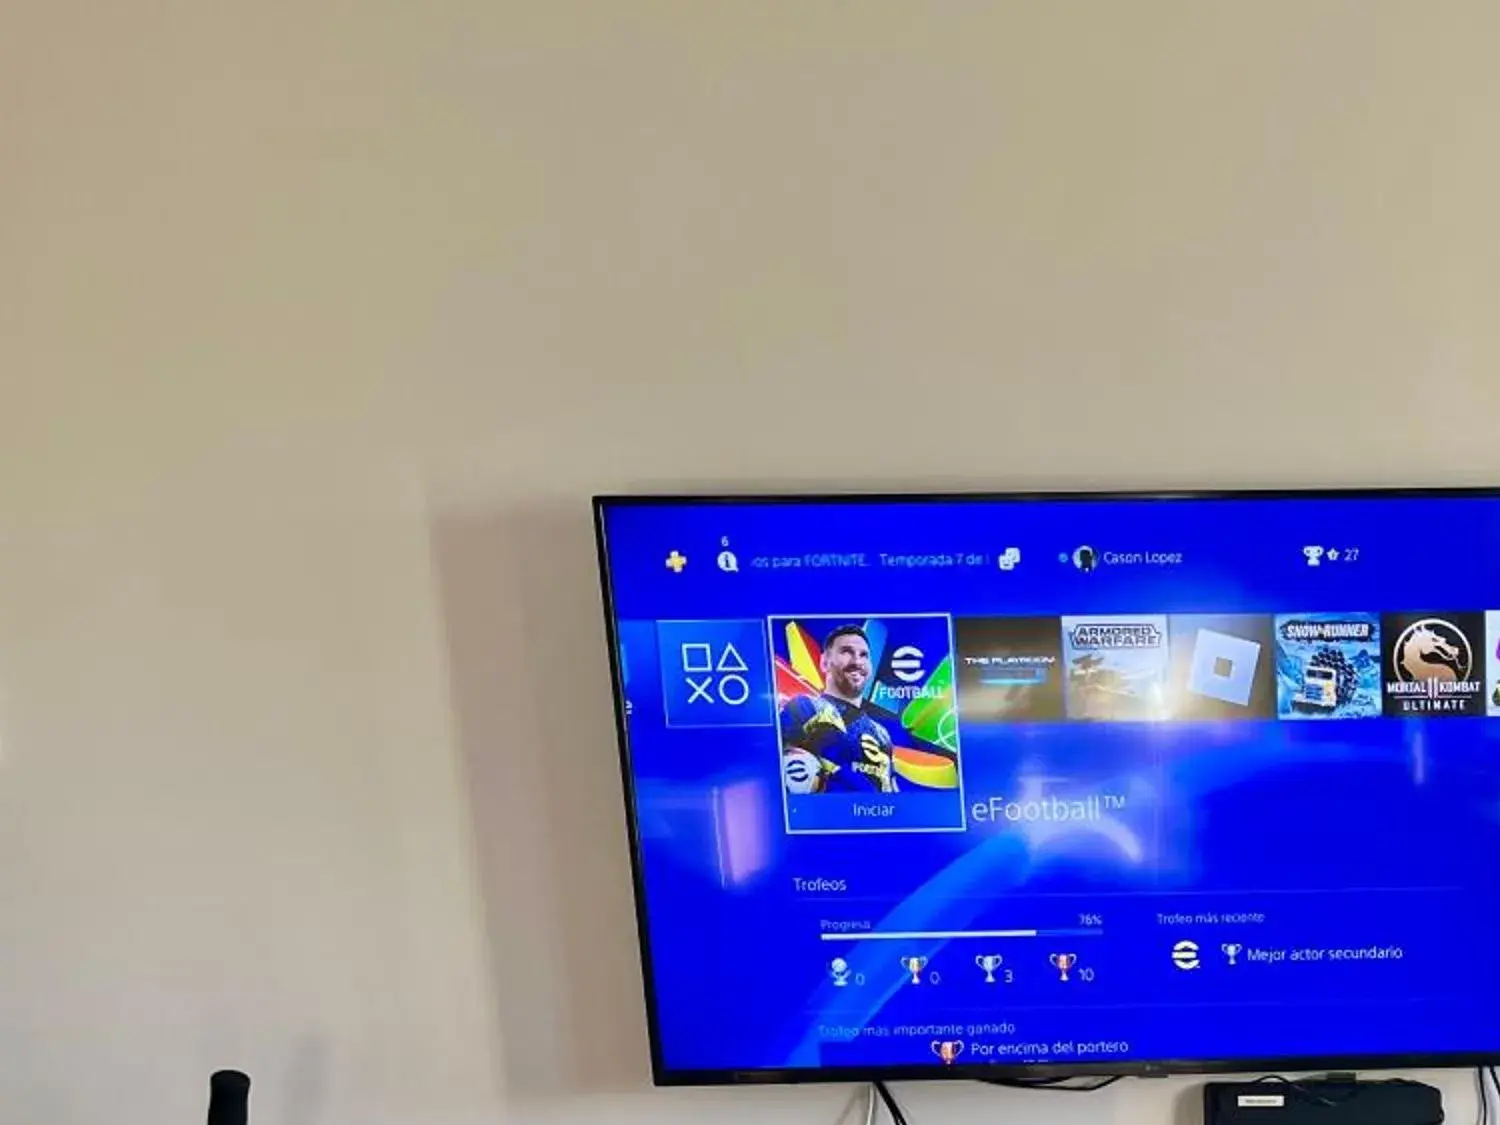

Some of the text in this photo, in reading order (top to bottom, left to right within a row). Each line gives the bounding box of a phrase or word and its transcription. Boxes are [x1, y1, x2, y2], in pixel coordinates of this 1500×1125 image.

[880, 553, 953, 570] Temporada
[1103, 551, 1143, 565] Cason
[1344, 547, 1360, 562] 27
[1077, 627, 1151, 637] ARMORED
[1075, 635, 1157, 646] WARFARE
[964, 656, 990, 666] THE
[1402, 699, 1466, 712] ULTIMATE
[853, 802, 895, 817] Iniciar
[792, 876, 847, 892] Trofeos
[1247, 945, 1404, 964] Mejor actor secundario
[1003, 969, 1014, 983] 3
[1078, 967, 1095, 982] 10
[893, 1023, 964, 1038] importante
[967, 1021, 1016, 1038] ganado
[971, 1041, 1130, 1057] Por encima del portero
